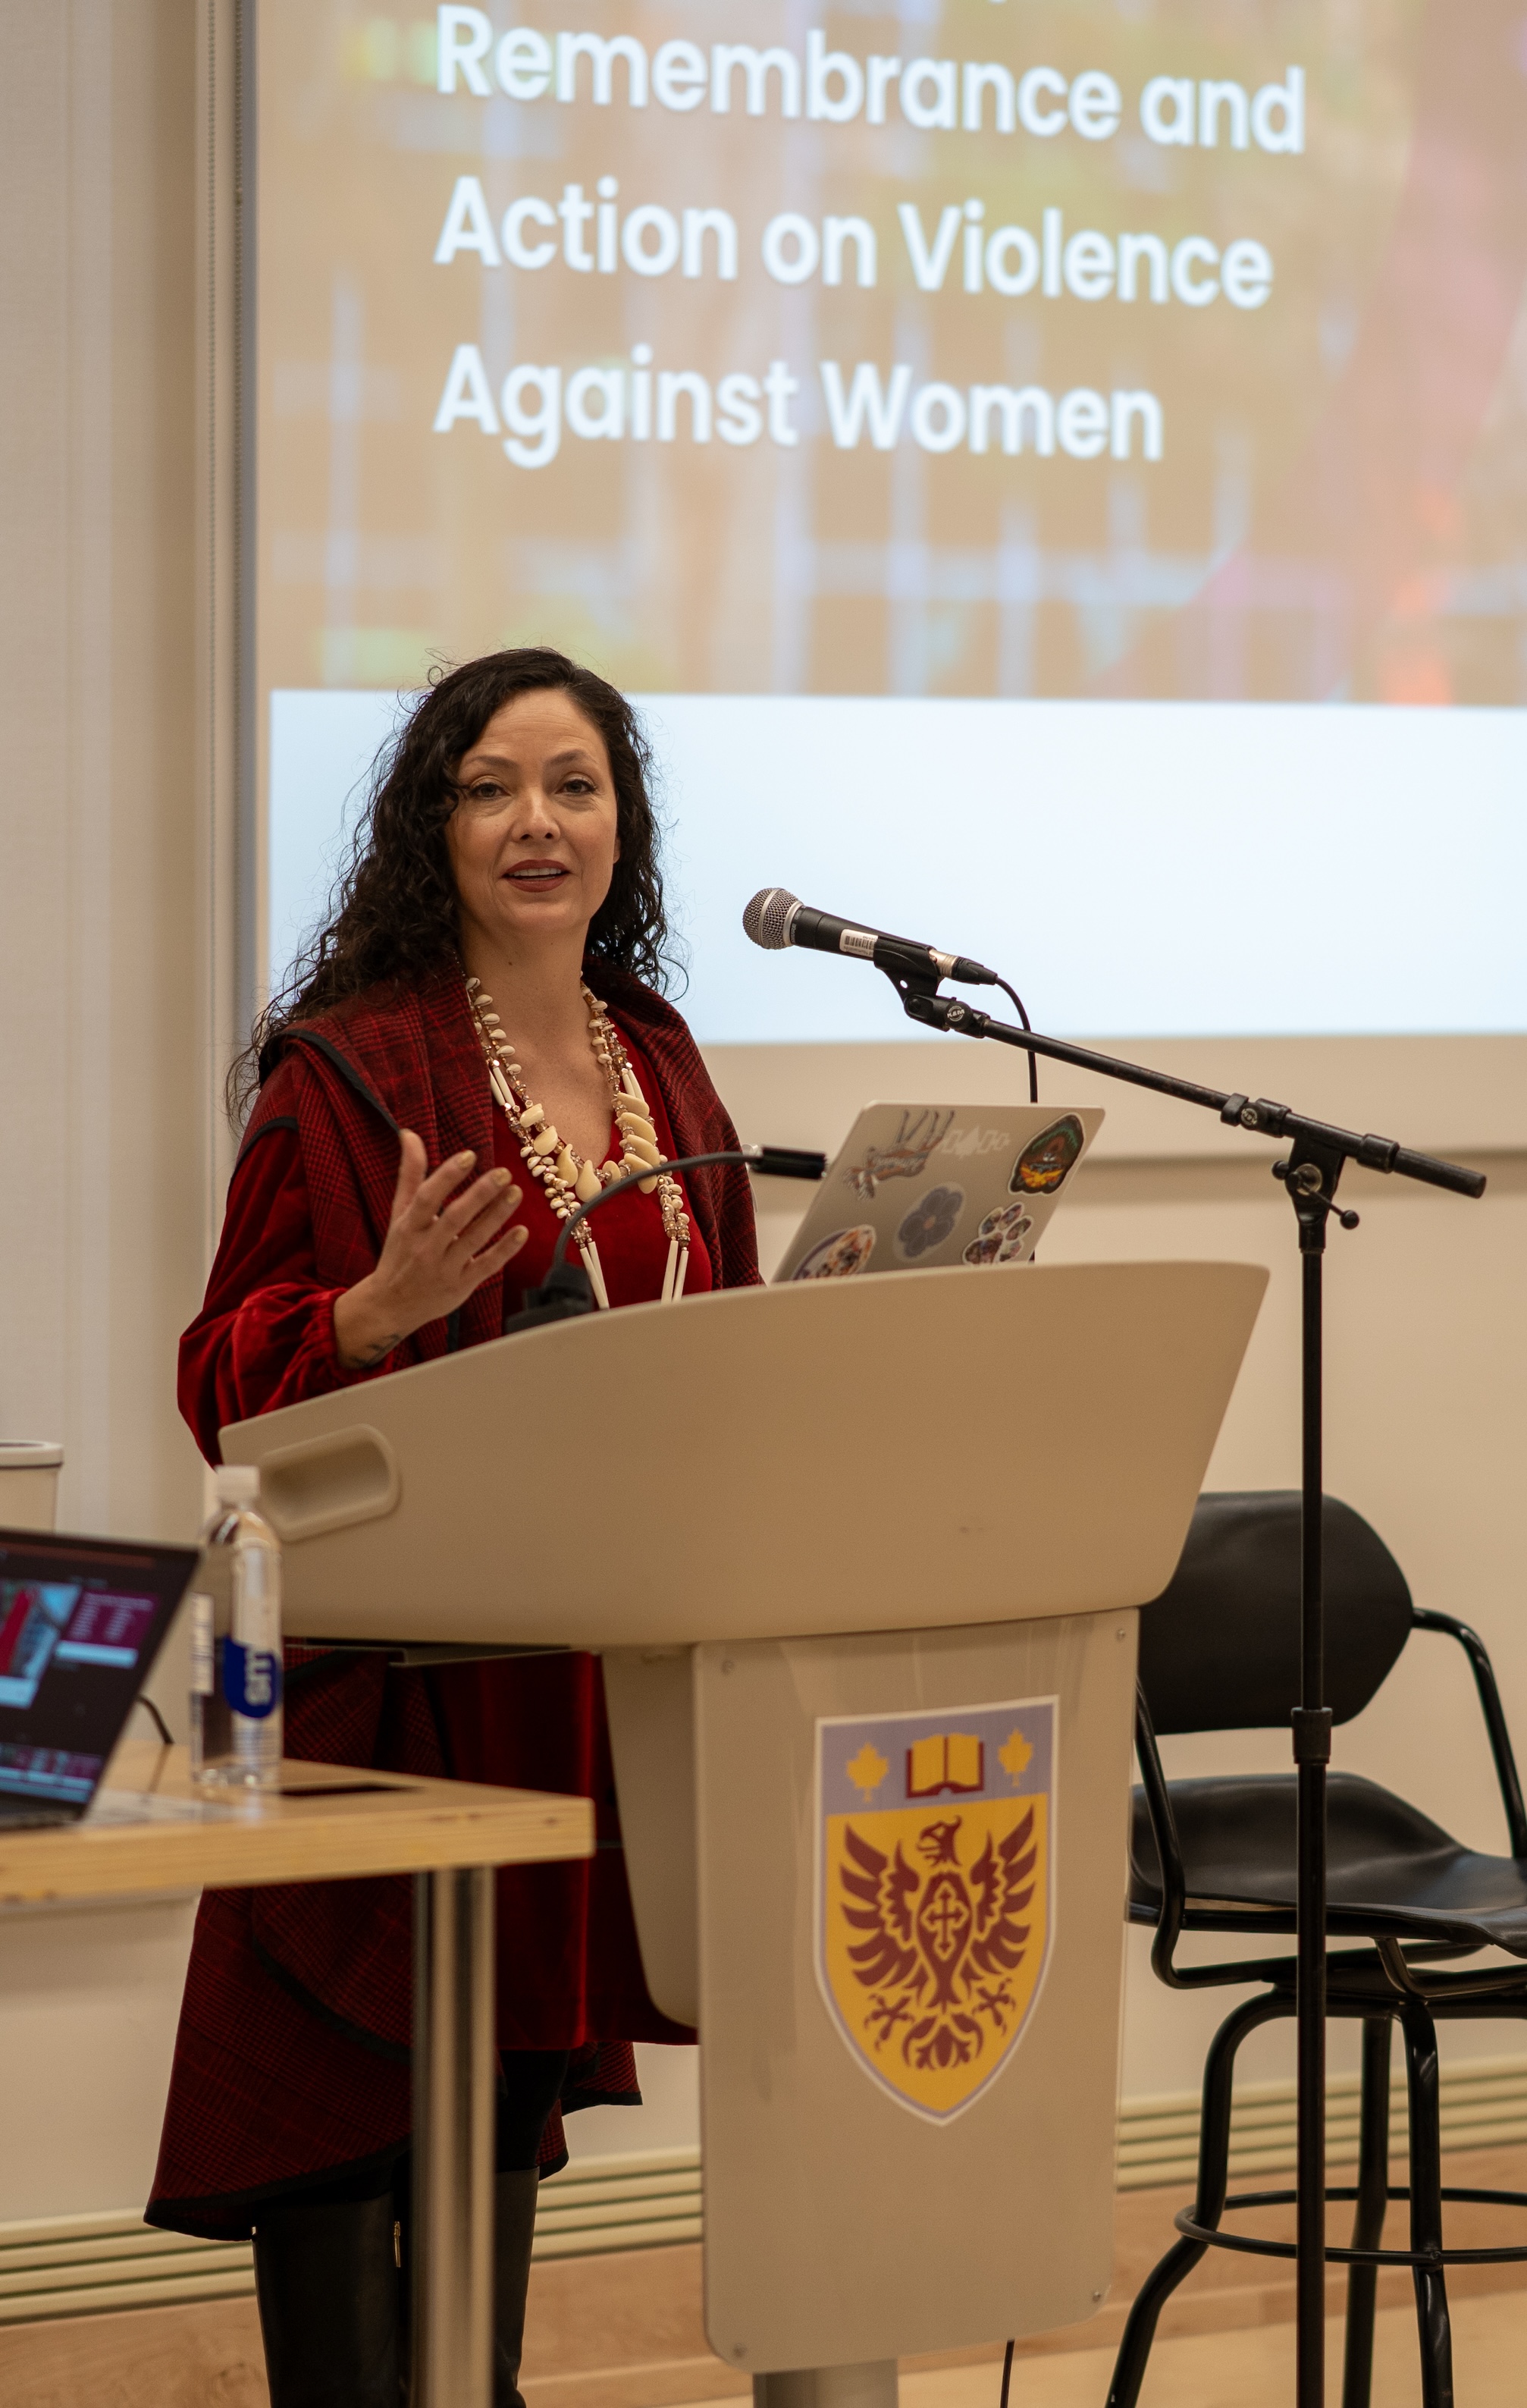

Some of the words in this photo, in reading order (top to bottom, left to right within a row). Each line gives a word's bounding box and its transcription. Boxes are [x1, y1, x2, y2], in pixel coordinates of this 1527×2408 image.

[437, 5, 1119, 139] Remembrance
[1142, 67, 1303, 152] and
[435, 177, 737, 279] Action
[762, 210, 875, 287] on
[899, 199, 1271, 307] Violence
[434, 343, 798, 467] Against
[821, 362, 1161, 459] Women
